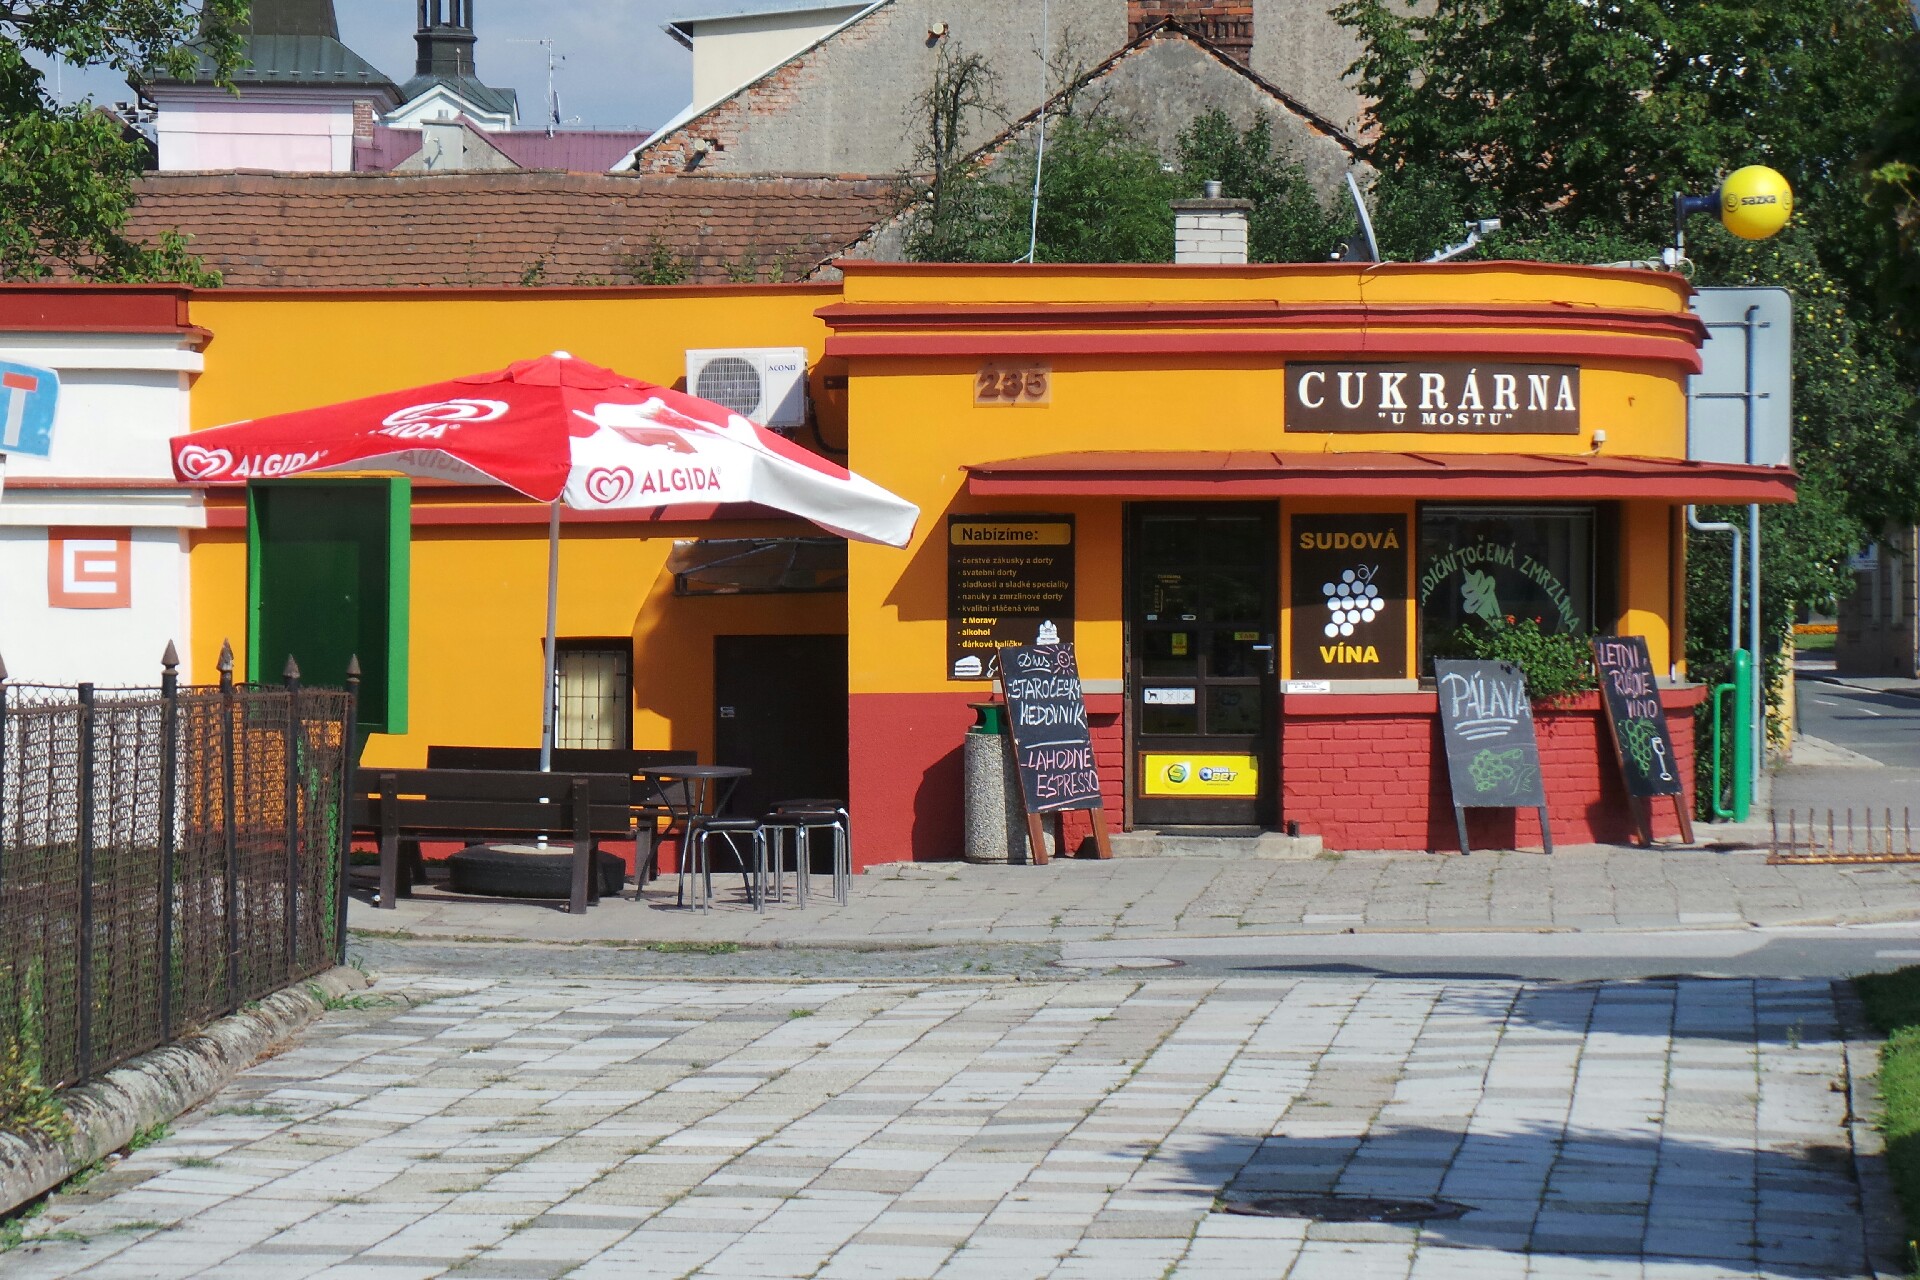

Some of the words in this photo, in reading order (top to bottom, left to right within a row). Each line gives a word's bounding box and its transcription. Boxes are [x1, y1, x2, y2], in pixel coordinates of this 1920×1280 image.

[977, 368, 1048, 400] 235
[1299, 368, 1576, 411] CUKRÁRNA
[1422, 412, 1513, 425] MOSTU"
[640, 467, 721, 494] ALGIDA
[962, 527, 1039, 541] Nabízíme:
[1300, 528, 1399, 549] SUDOVÁ
[1033, 557, 1053, 565] dorty
[997, 568, 1017, 577] dorty
[962, 580, 997, 588] sladkosti
[1005, 580, 1031, 588] sladké
[1032, 580, 1069, 590] speciality
[962, 592, 990, 601] nanuky
[1042, 592, 1063, 601] dorty
[968, 617, 997, 626] Moravy
[962, 628, 991, 636] alkohol
[962, 639, 993, 648] dárkové
[1320, 641, 1379, 664] VÍNA
[1441, 670, 1531, 719] PÁLAVA
[1037, 770, 1099, 798] ESPRESSO
